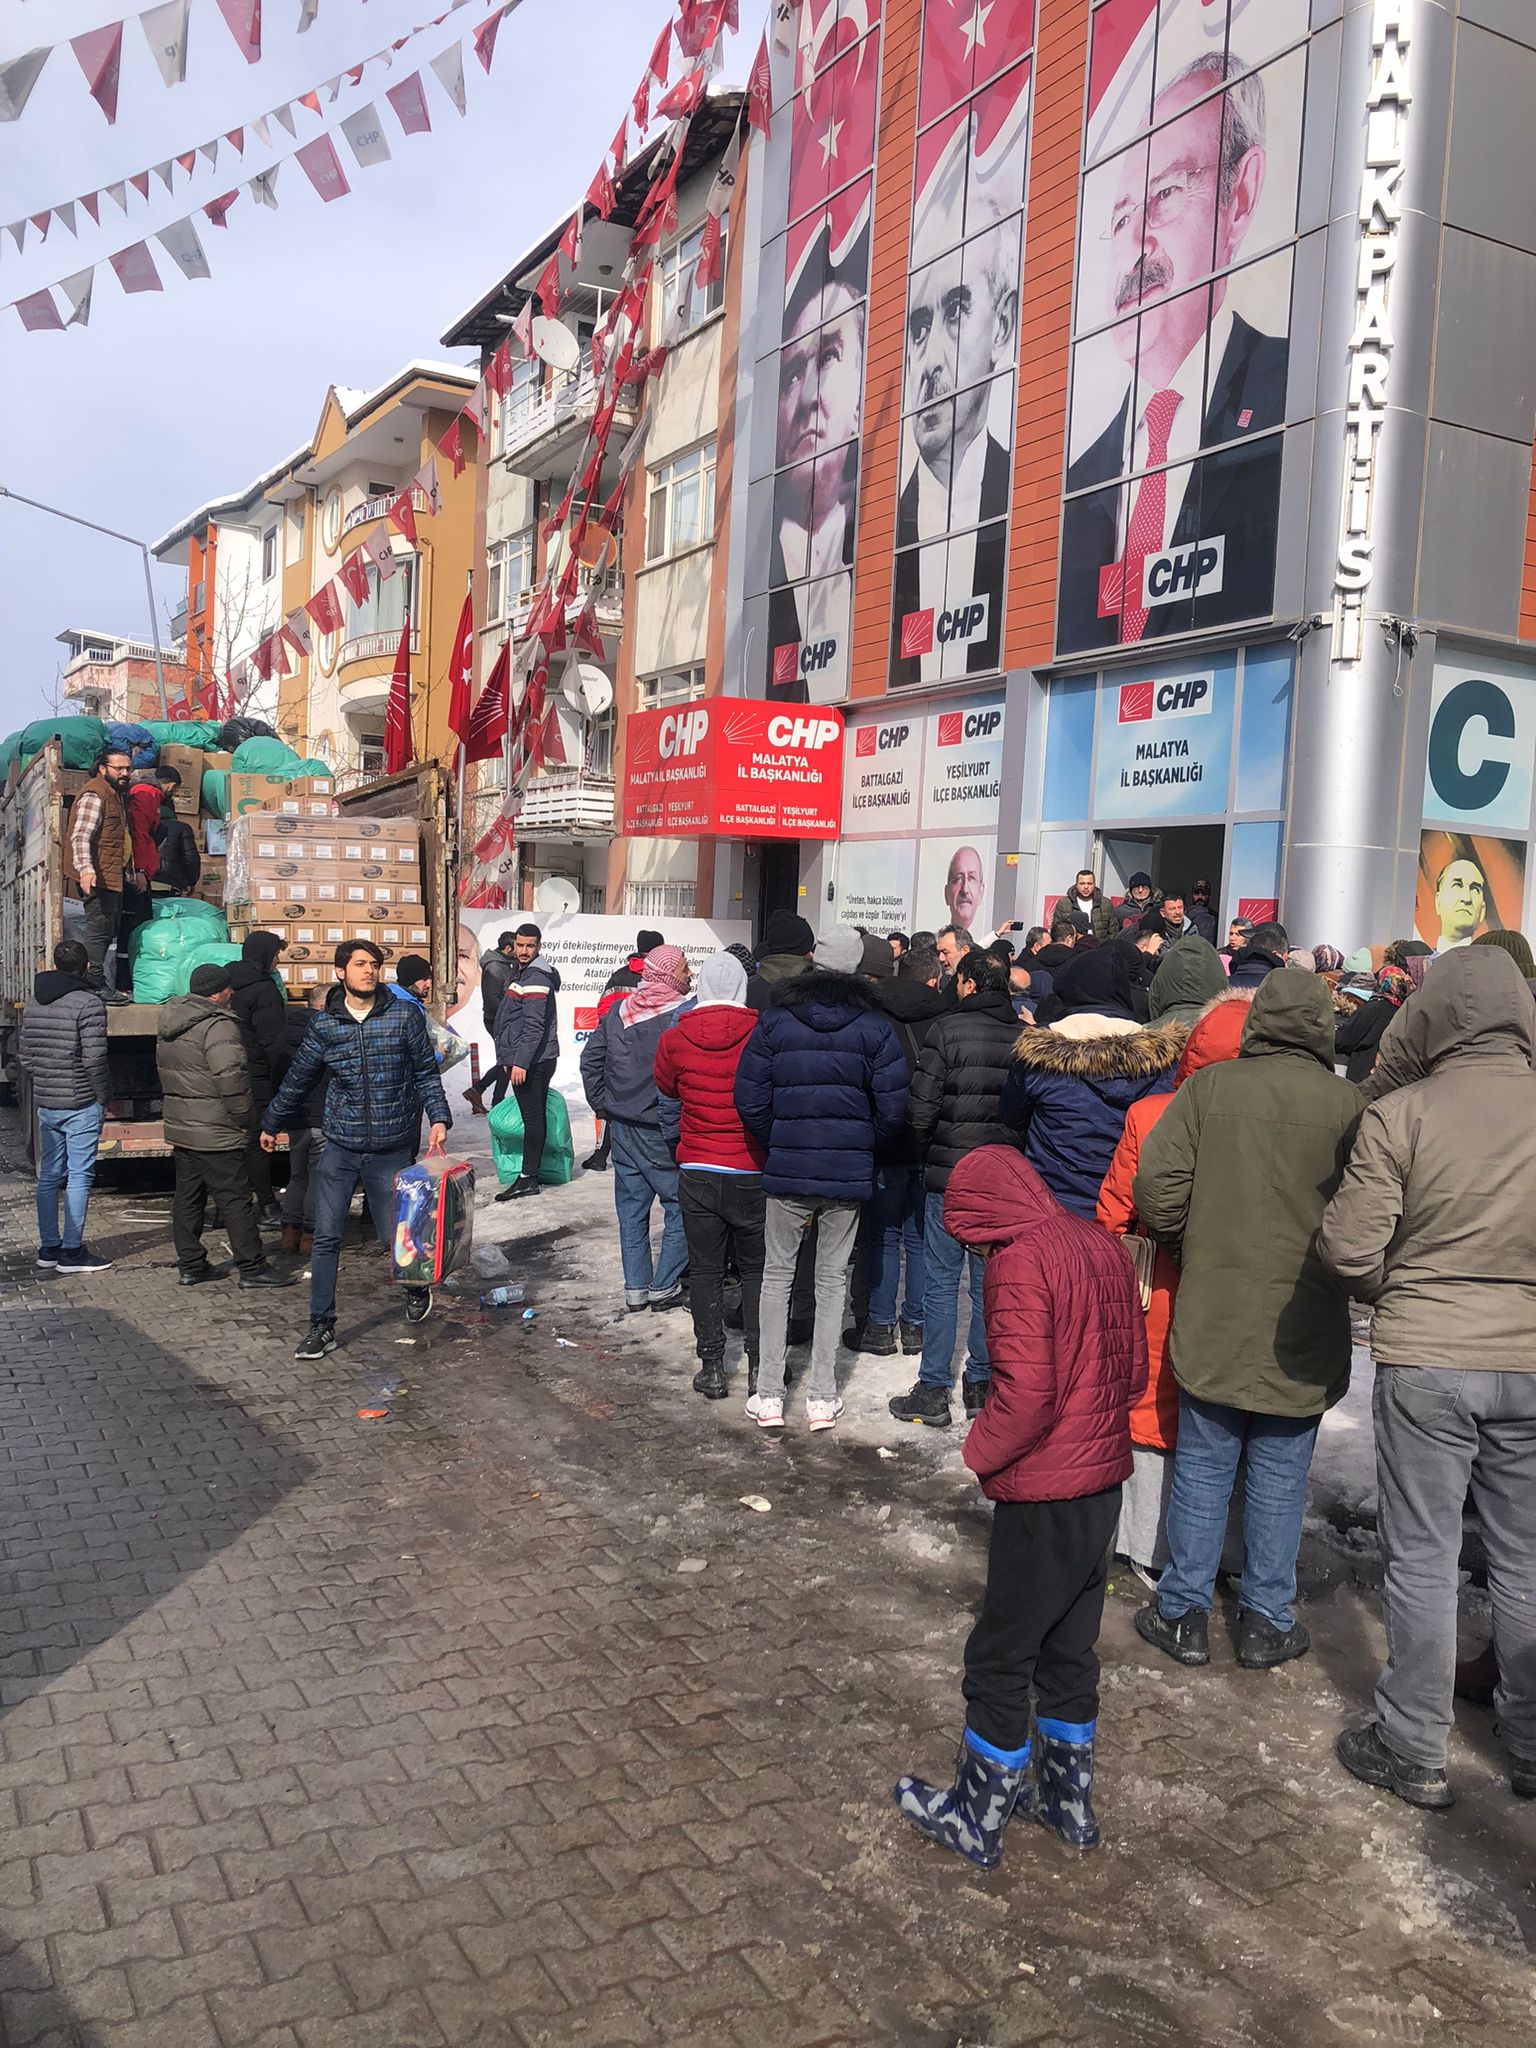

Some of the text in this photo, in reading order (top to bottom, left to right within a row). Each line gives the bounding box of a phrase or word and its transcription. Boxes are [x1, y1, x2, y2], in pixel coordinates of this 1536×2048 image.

[355, 130, 380, 148] CHP
[716, 163, 736, 187] HP
[1148, 546, 1218, 598] CHP
[936, 602, 985, 644] CHP
[800, 638, 837, 673] CHP
[1156, 679, 1208, 712] CHP
[658, 708, 710, 760] CHP
[767, 715, 840, 750] CHP
[964, 710, 1001, 738] CHP
[878, 725, 910, 750] CHP
[1428, 679, 1516, 811] C
[752, 752, 809, 768] MALATYA
[1135, 739, 1190, 761] MALATYA
[630, 769, 659, 786] MALATYA
[665, 762, 708, 784] BAŞKANLIĞI
[737, 763, 823, 784] İL BAŞKANLIĞI
[861, 768, 904, 788] BATTALGAZİ
[946, 760, 991, 781] YEŞİLYURT
[1120, 761, 1203, 788] İL BAŞKANLIĞI
[852, 788, 911, 810] İLÇE BAŞKANLIĞI
[932, 785, 950, 804] İLÇE
[735, 803, 777, 814] BATTALGAZİ
[782, 806, 818, 817] YEŞİLYURT
[719, 814, 776, 826] İLÇE BAŞKANLIĞI
[782, 818, 836, 829] İLÇE BAŞKANLIĞI
[882, 895, 903, 906] bölüşen
[571, 954, 617, 965] demokrasi
